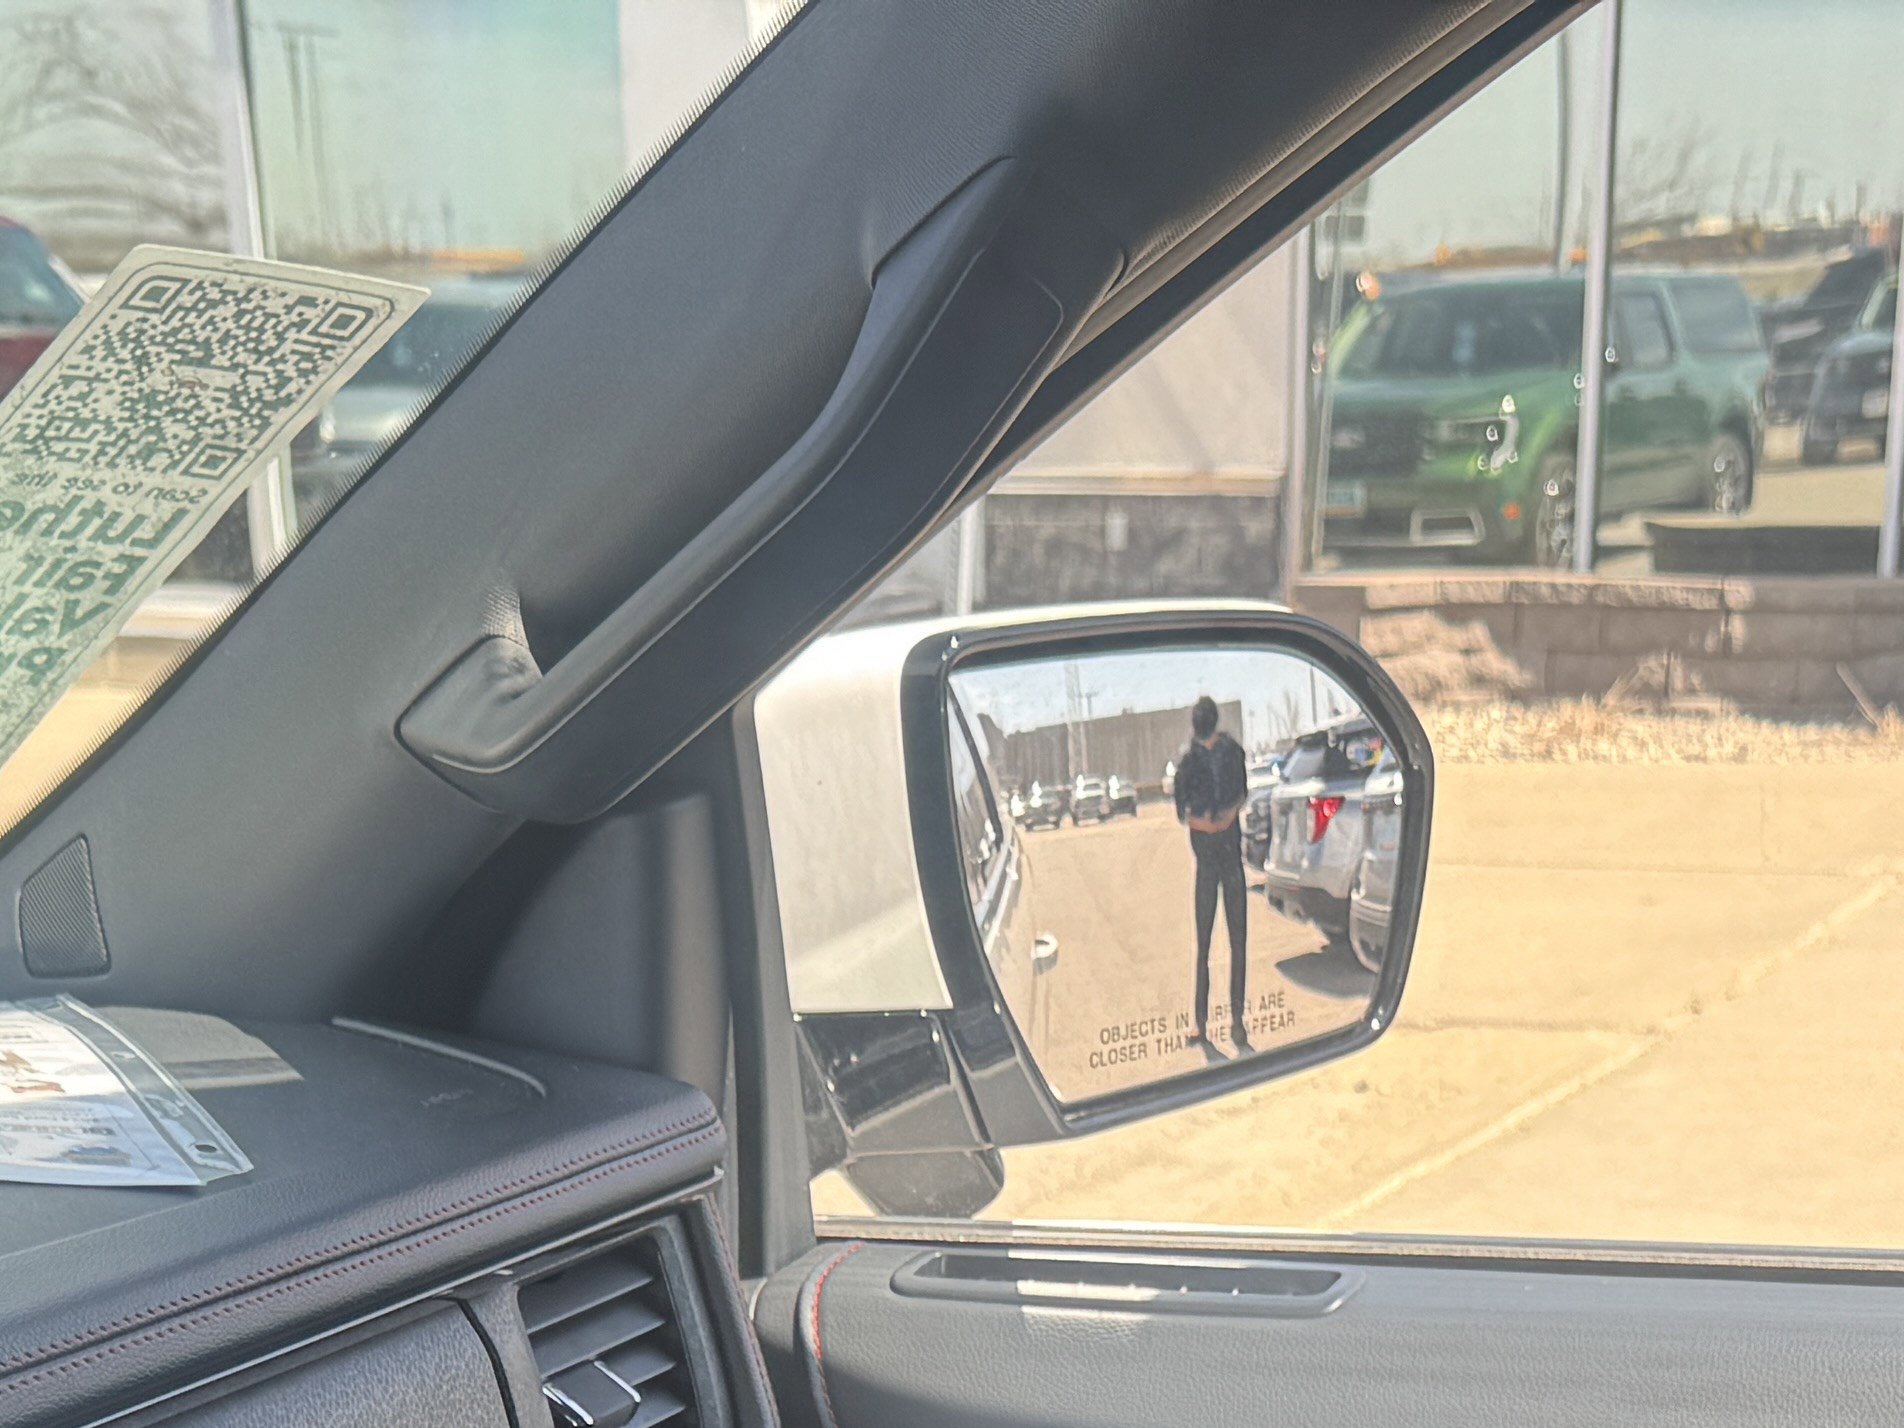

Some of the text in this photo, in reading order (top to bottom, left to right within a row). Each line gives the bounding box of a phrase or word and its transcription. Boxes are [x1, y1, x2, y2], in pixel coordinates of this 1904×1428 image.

[1100, 1017, 1168, 1045] OBJECTS
[1175, 1012, 1190, 1030] IN
[1258, 991, 1286, 1011] ARE
[1089, 1042, 1148, 1069] CLOSER
